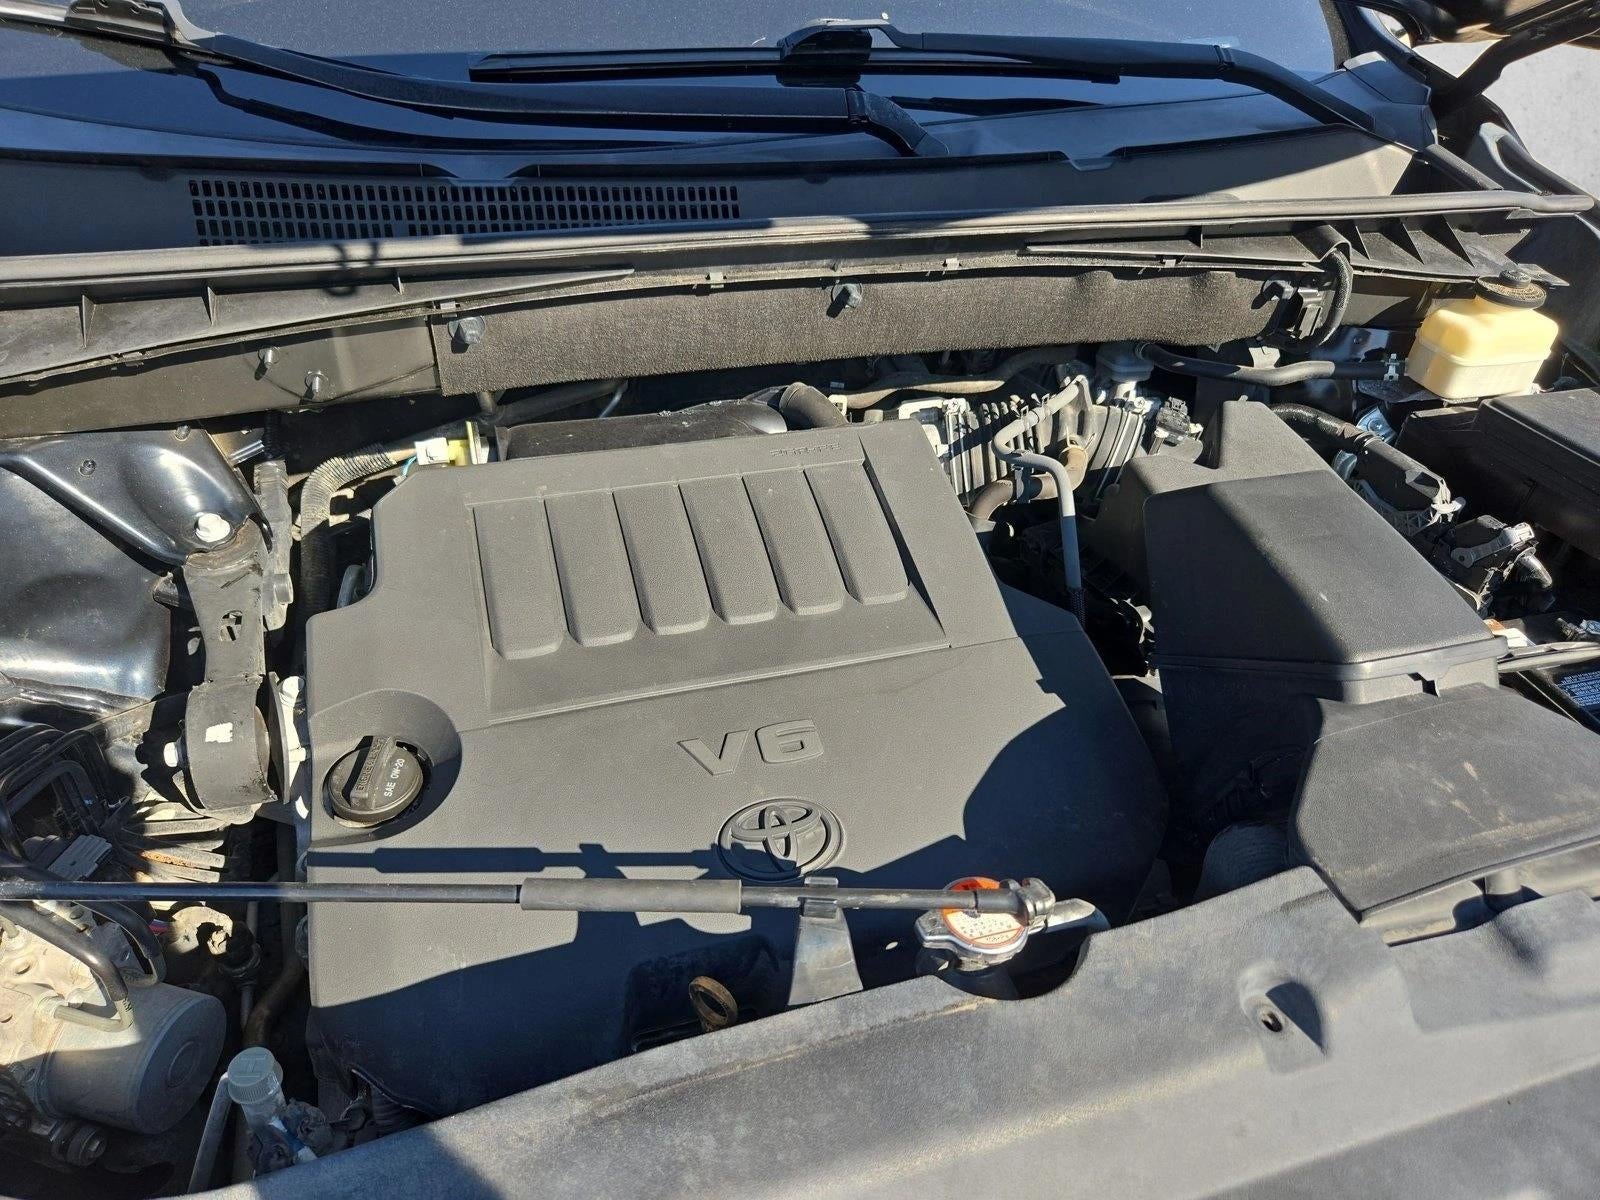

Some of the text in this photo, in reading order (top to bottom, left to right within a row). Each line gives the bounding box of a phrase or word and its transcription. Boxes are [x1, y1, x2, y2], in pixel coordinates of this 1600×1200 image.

[676, 718, 825, 776] V6
[383, 758, 406, 797] SAE 0W-20
